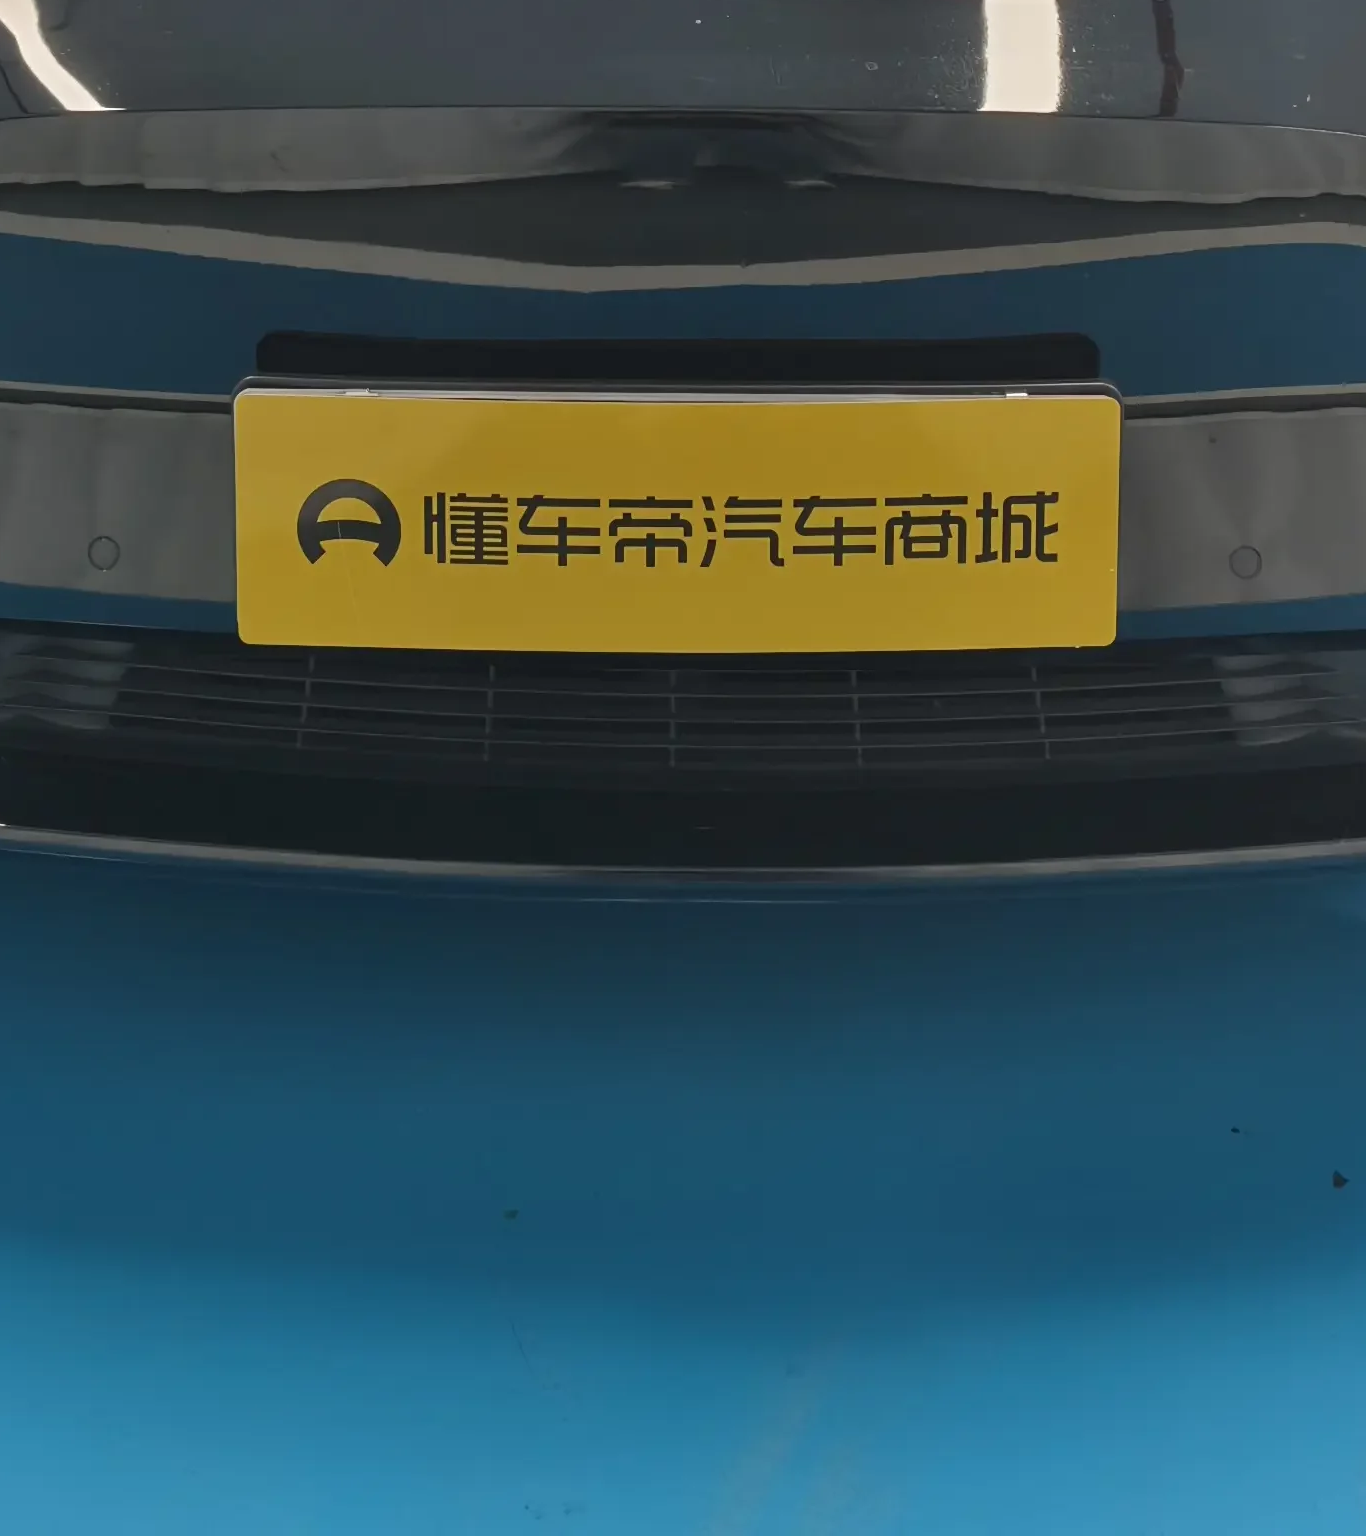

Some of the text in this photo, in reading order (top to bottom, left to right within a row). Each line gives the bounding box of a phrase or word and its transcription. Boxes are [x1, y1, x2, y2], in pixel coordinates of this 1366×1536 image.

[422, 491, 1059, 568] 懂车帝汽车商城
